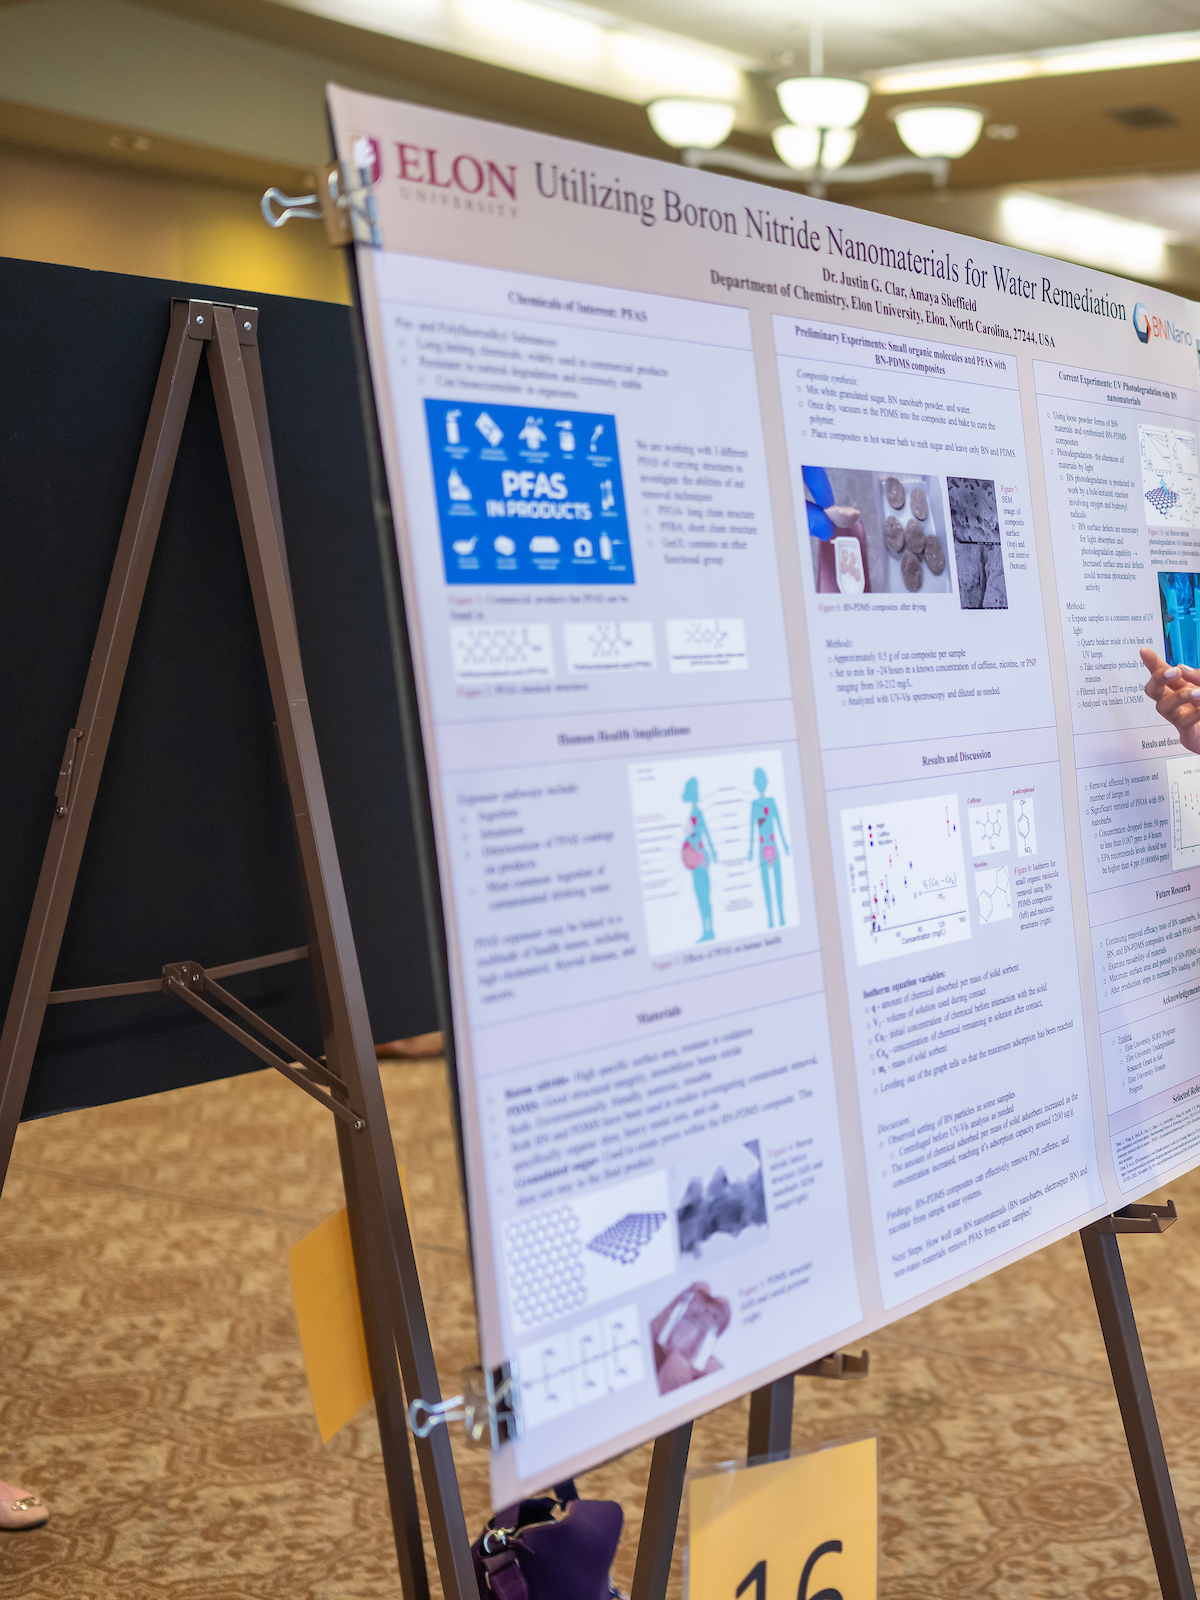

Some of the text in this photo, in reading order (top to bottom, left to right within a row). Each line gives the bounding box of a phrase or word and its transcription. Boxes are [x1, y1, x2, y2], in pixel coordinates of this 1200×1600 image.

[396, 143, 516, 200] ELON
[400, 187, 518, 219] UNIVERSITY
[535, 162, 1126, 320] Utilizing Boron Nitride Nanomaterials for Water Remediation
[822, 267, 977, 312] Dr. Justin G. Clar, Amaya Sheffield
[710, 269, 1055, 348] Department of Chemistry, Elon University, Elon, North Carolina, 27244, USA
[1152, 316, 1193, 346] BNNano
[795, 325, 1007, 370] Preliminary Experiments: Small organic molecules and PFAS with
[875, 354, 946, 375] BN-PDMS composites
[1058, 371, 1177, 400] Current Experiments: UV Photodegradation with BN
[1107, 395, 1141, 406] nanomaterials
[501, 469, 568, 500] PFAS
[486, 499, 506, 518] IN
[506, 499, 593, 520] PRODUCTS
[922, 749, 991, 766] Results and Discussion
[1141, 740, 1158, 749] Results
[1158, 738, 1167, 747] and
[1155, 883, 1191, 899] Future Research
[1172, 1089, 1190, 1104] Selected
